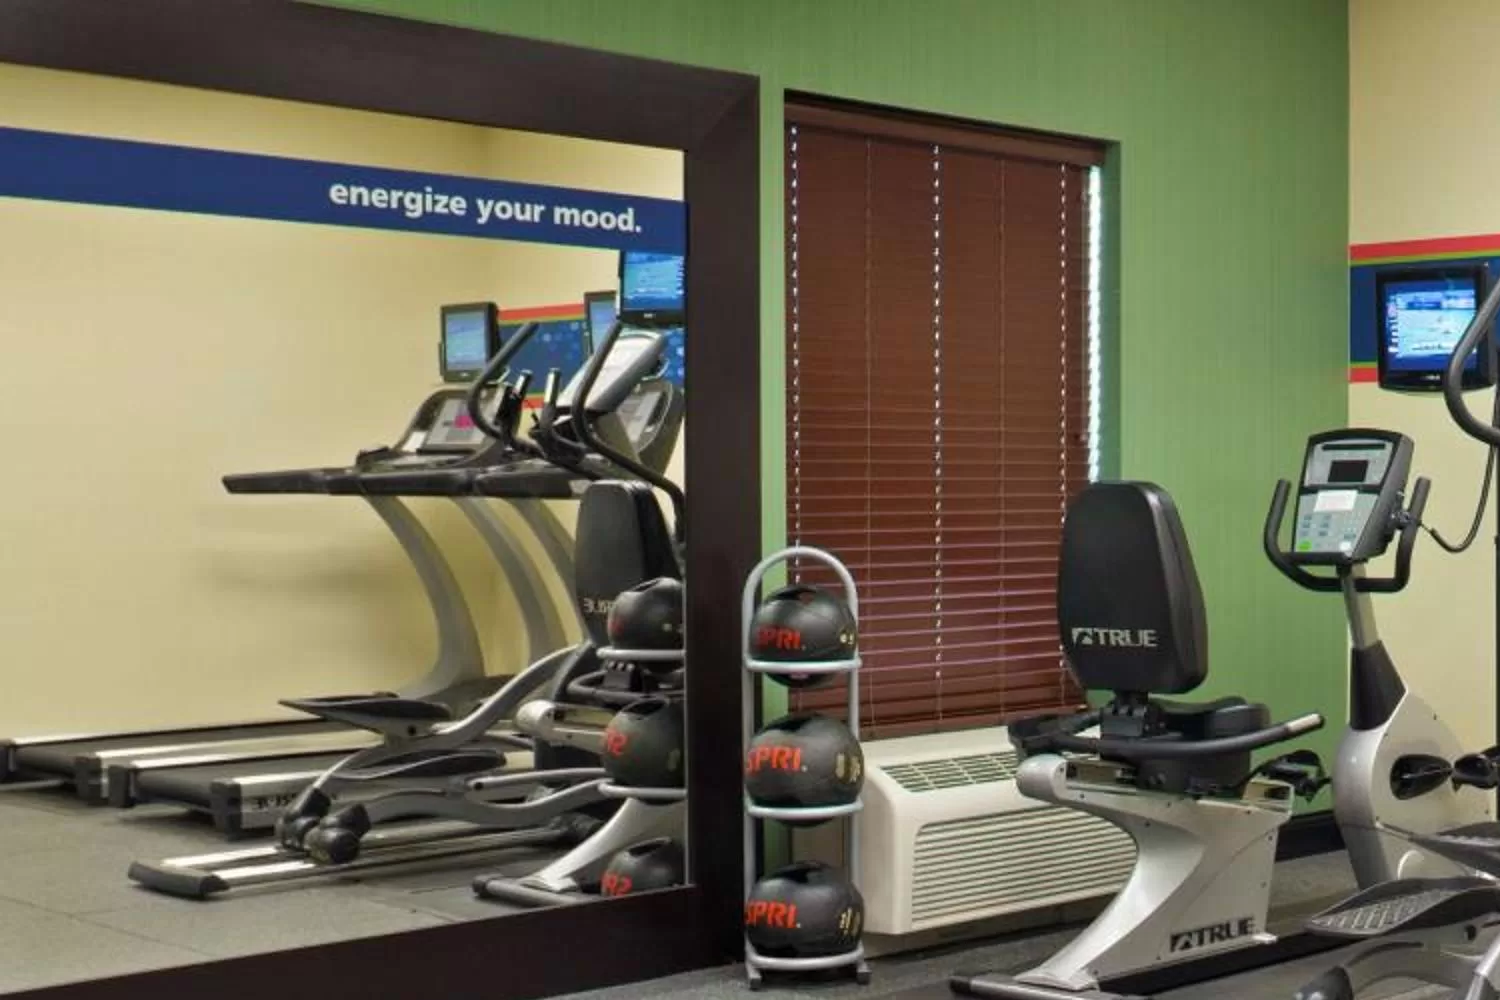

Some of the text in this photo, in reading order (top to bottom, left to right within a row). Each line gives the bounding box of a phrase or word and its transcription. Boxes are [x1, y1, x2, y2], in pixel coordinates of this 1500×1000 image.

[328, 182, 643, 233] energize your mood.
[1093, 628, 1158, 648] TRUE
[1196, 916, 1254, 947] TRUE
